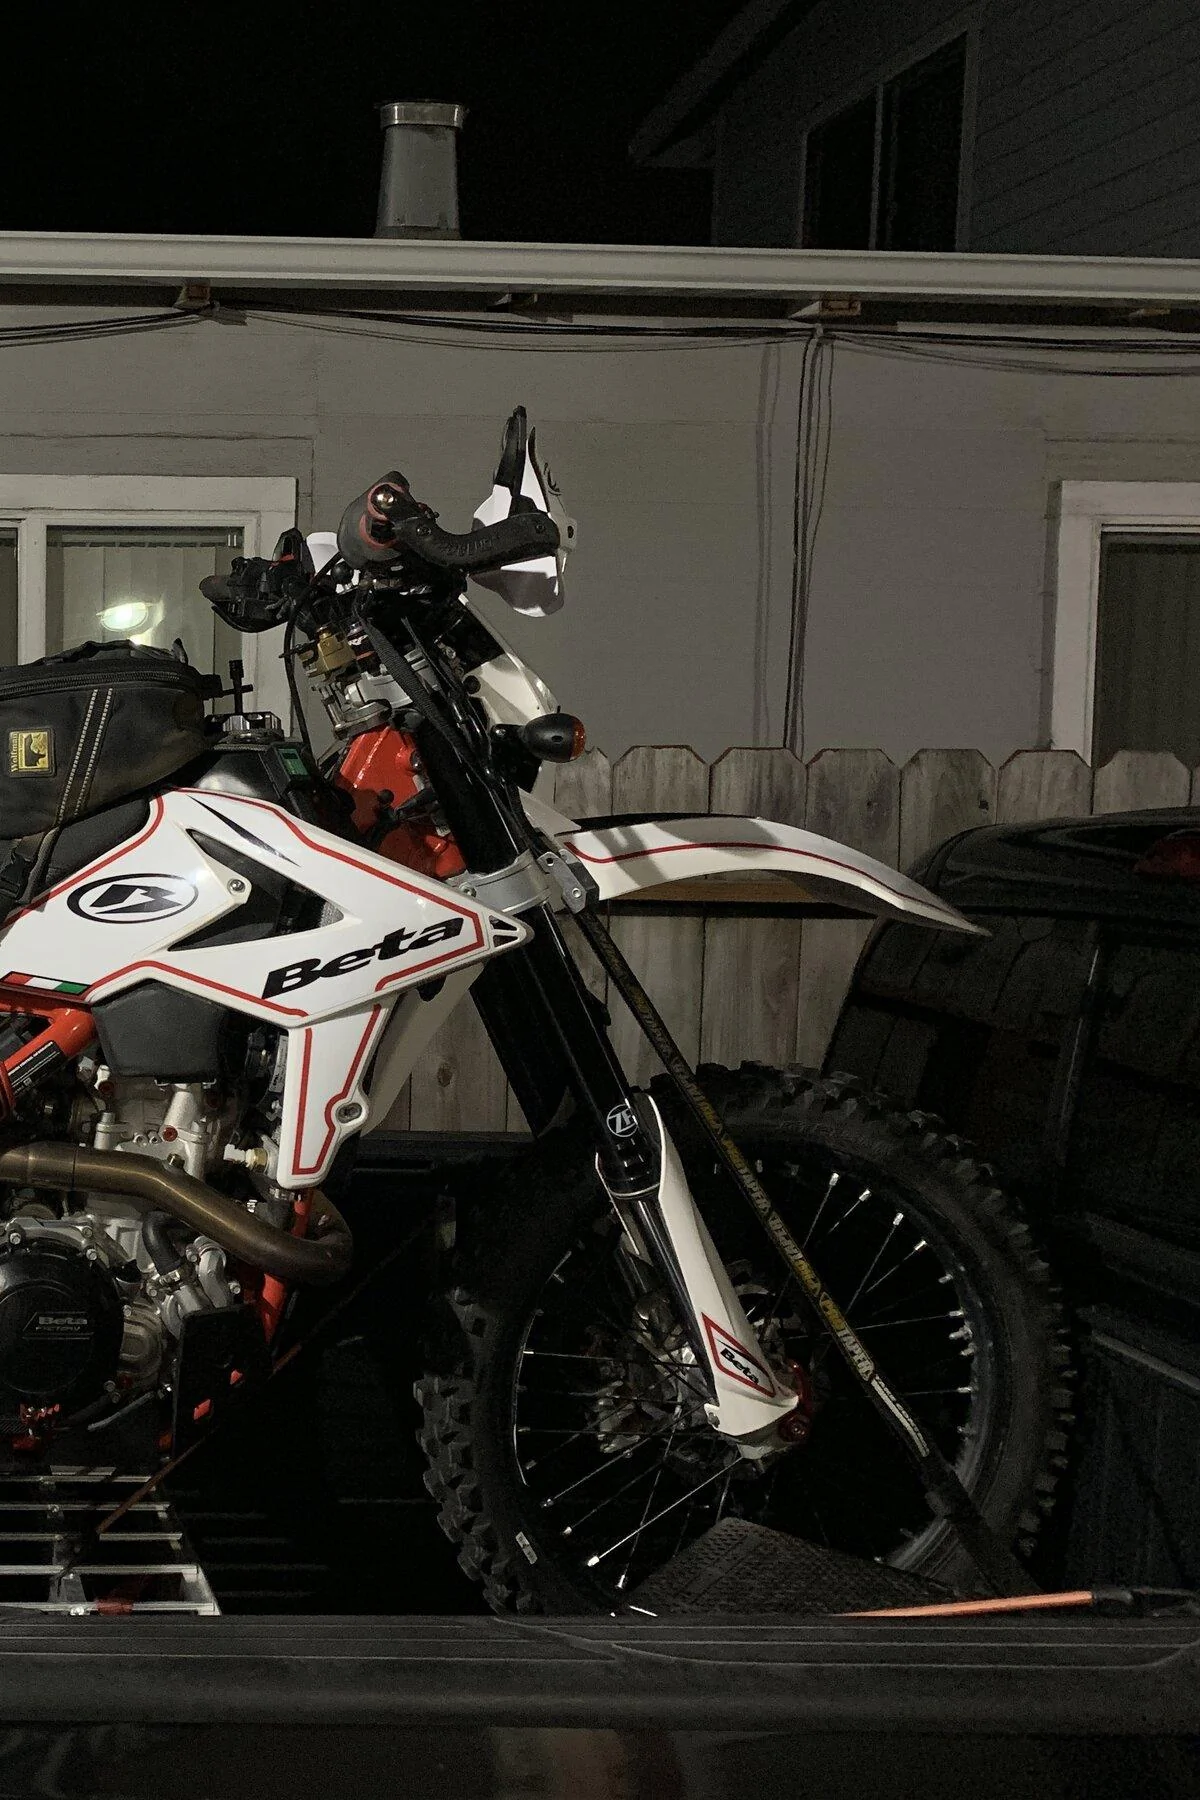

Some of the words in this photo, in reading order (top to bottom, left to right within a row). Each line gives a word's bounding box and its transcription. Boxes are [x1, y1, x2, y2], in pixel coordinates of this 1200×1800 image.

[262, 917, 464, 1000] Beta
[608, 1107, 636, 1134] ZF
[720, 1348, 759, 1386] Beta
